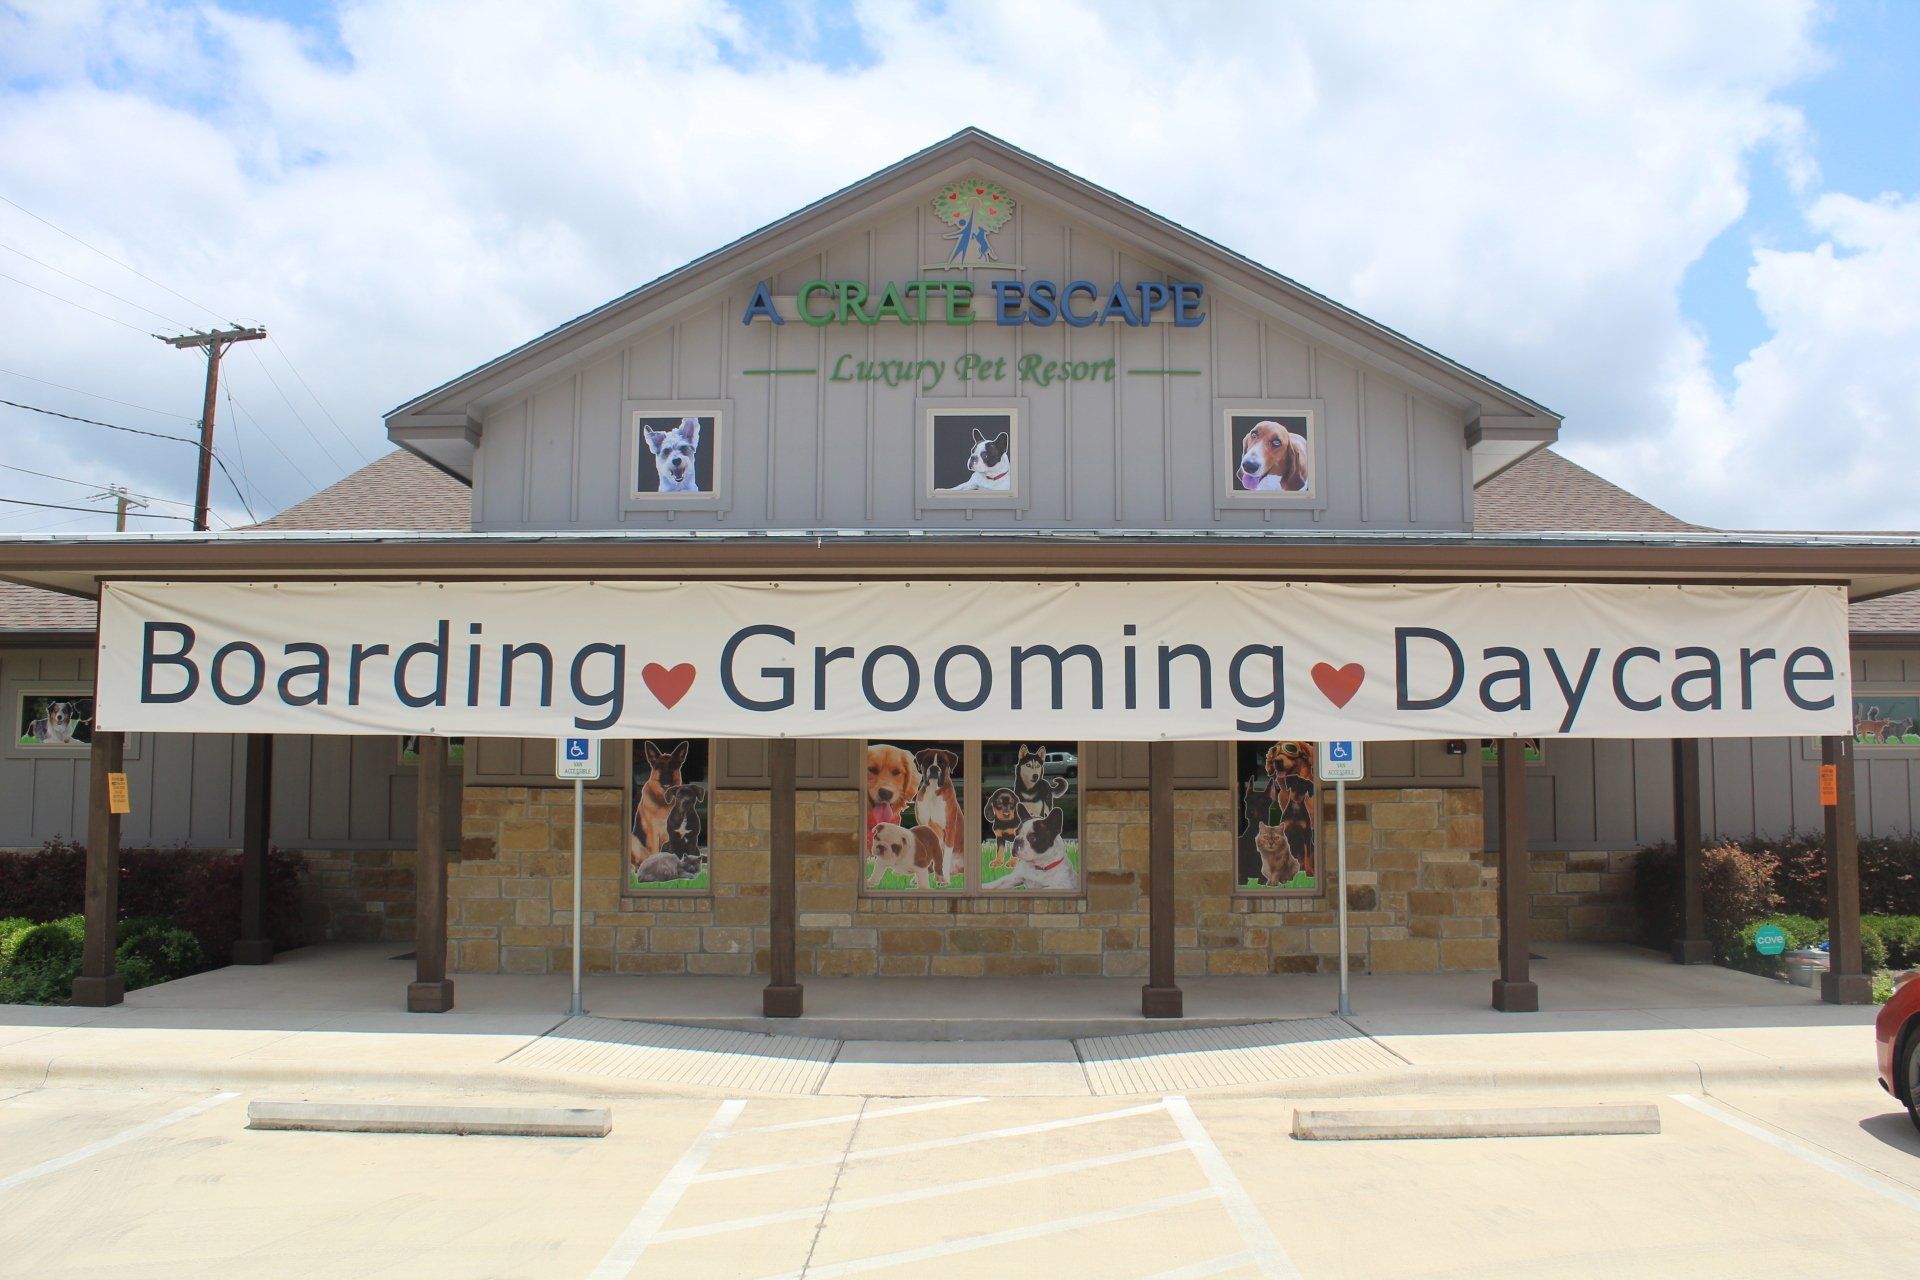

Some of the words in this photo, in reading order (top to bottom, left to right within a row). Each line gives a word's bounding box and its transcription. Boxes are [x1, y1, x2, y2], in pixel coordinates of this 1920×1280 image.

[742, 280, 785, 327] A
[796, 279, 976, 327] CRATE
[991, 279, 1206, 328] ESCAPE
[829, 353, 945, 391] Luxury
[955, 353, 1007, 386] Pet
[1017, 353, 1117, 386] Resort
[139, 619, 626, 730] Boarding
[719, 623, 1286, 733] Grooming
[1394, 625, 1837, 734] Daycare
[1757, 935, 1784, 944] cove
